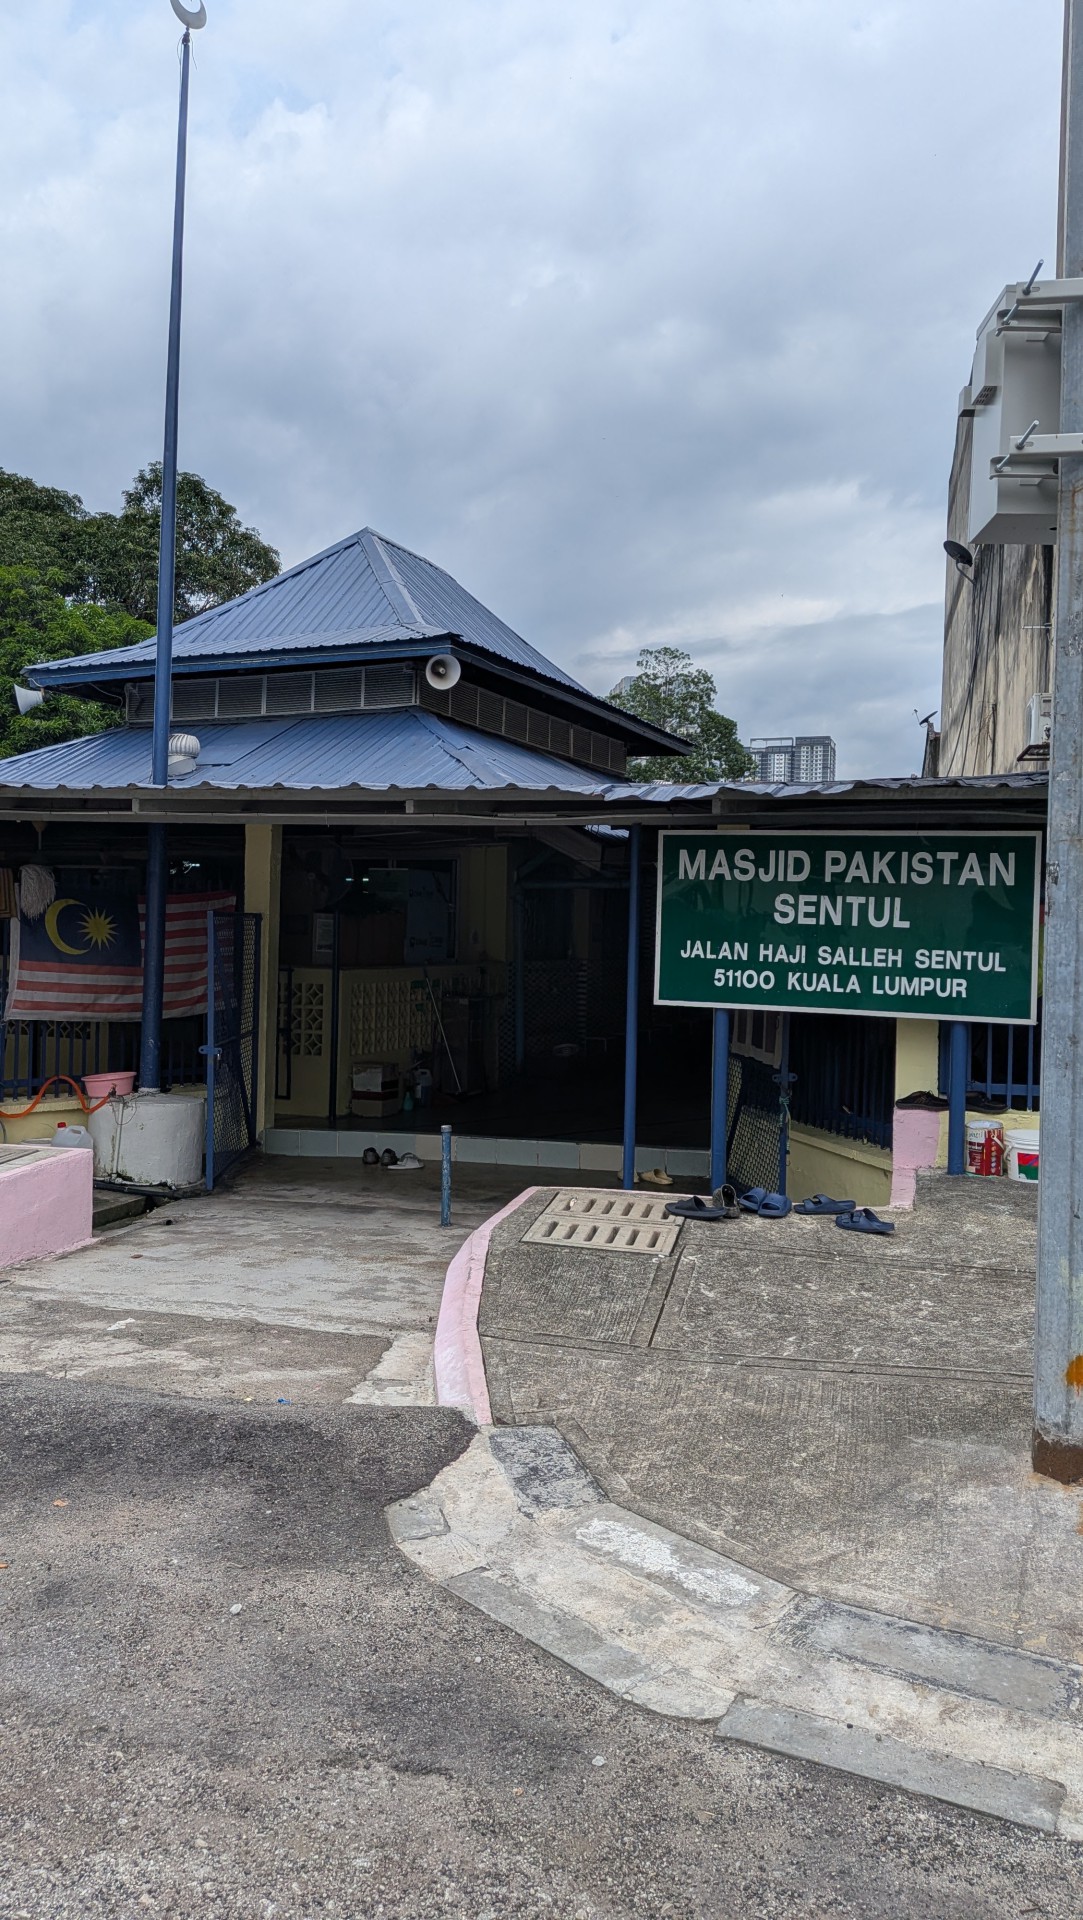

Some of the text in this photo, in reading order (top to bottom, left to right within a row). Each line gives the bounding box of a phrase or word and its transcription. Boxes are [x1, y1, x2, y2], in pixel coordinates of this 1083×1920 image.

[679, 849, 1014, 885] MASJID PAKISTAN
[774, 894, 910, 928] SENTUL
[681, 941, 1006, 971] JALAN HAJI SALLEH SENTUL
[714, 969, 967, 997] 51100 KUALA LUMPUR
